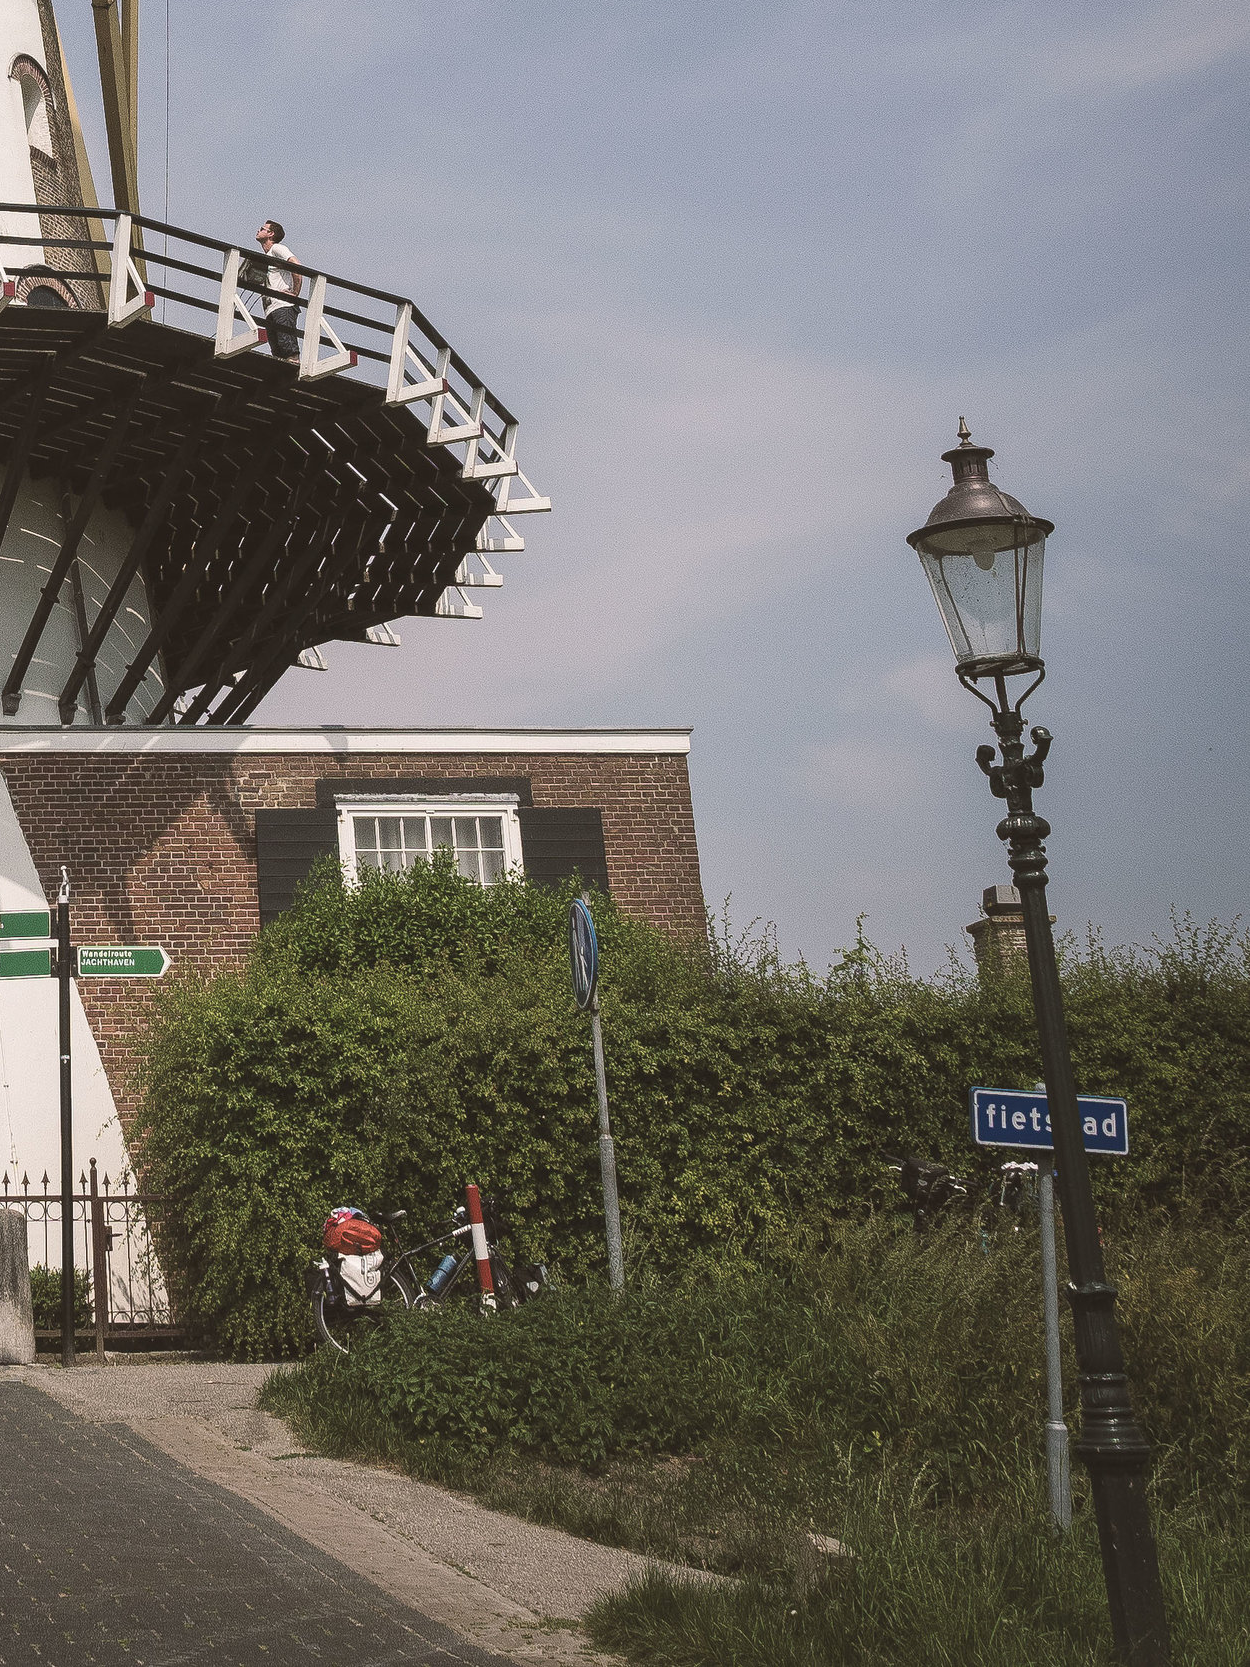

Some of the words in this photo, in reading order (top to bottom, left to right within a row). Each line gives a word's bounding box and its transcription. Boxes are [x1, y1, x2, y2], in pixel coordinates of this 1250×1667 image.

[82, 950, 133, 958] Wandelroute
[81, 958, 136, 966] JACHTHAVEN
[986, 1103, 1117, 1138] fietsad
